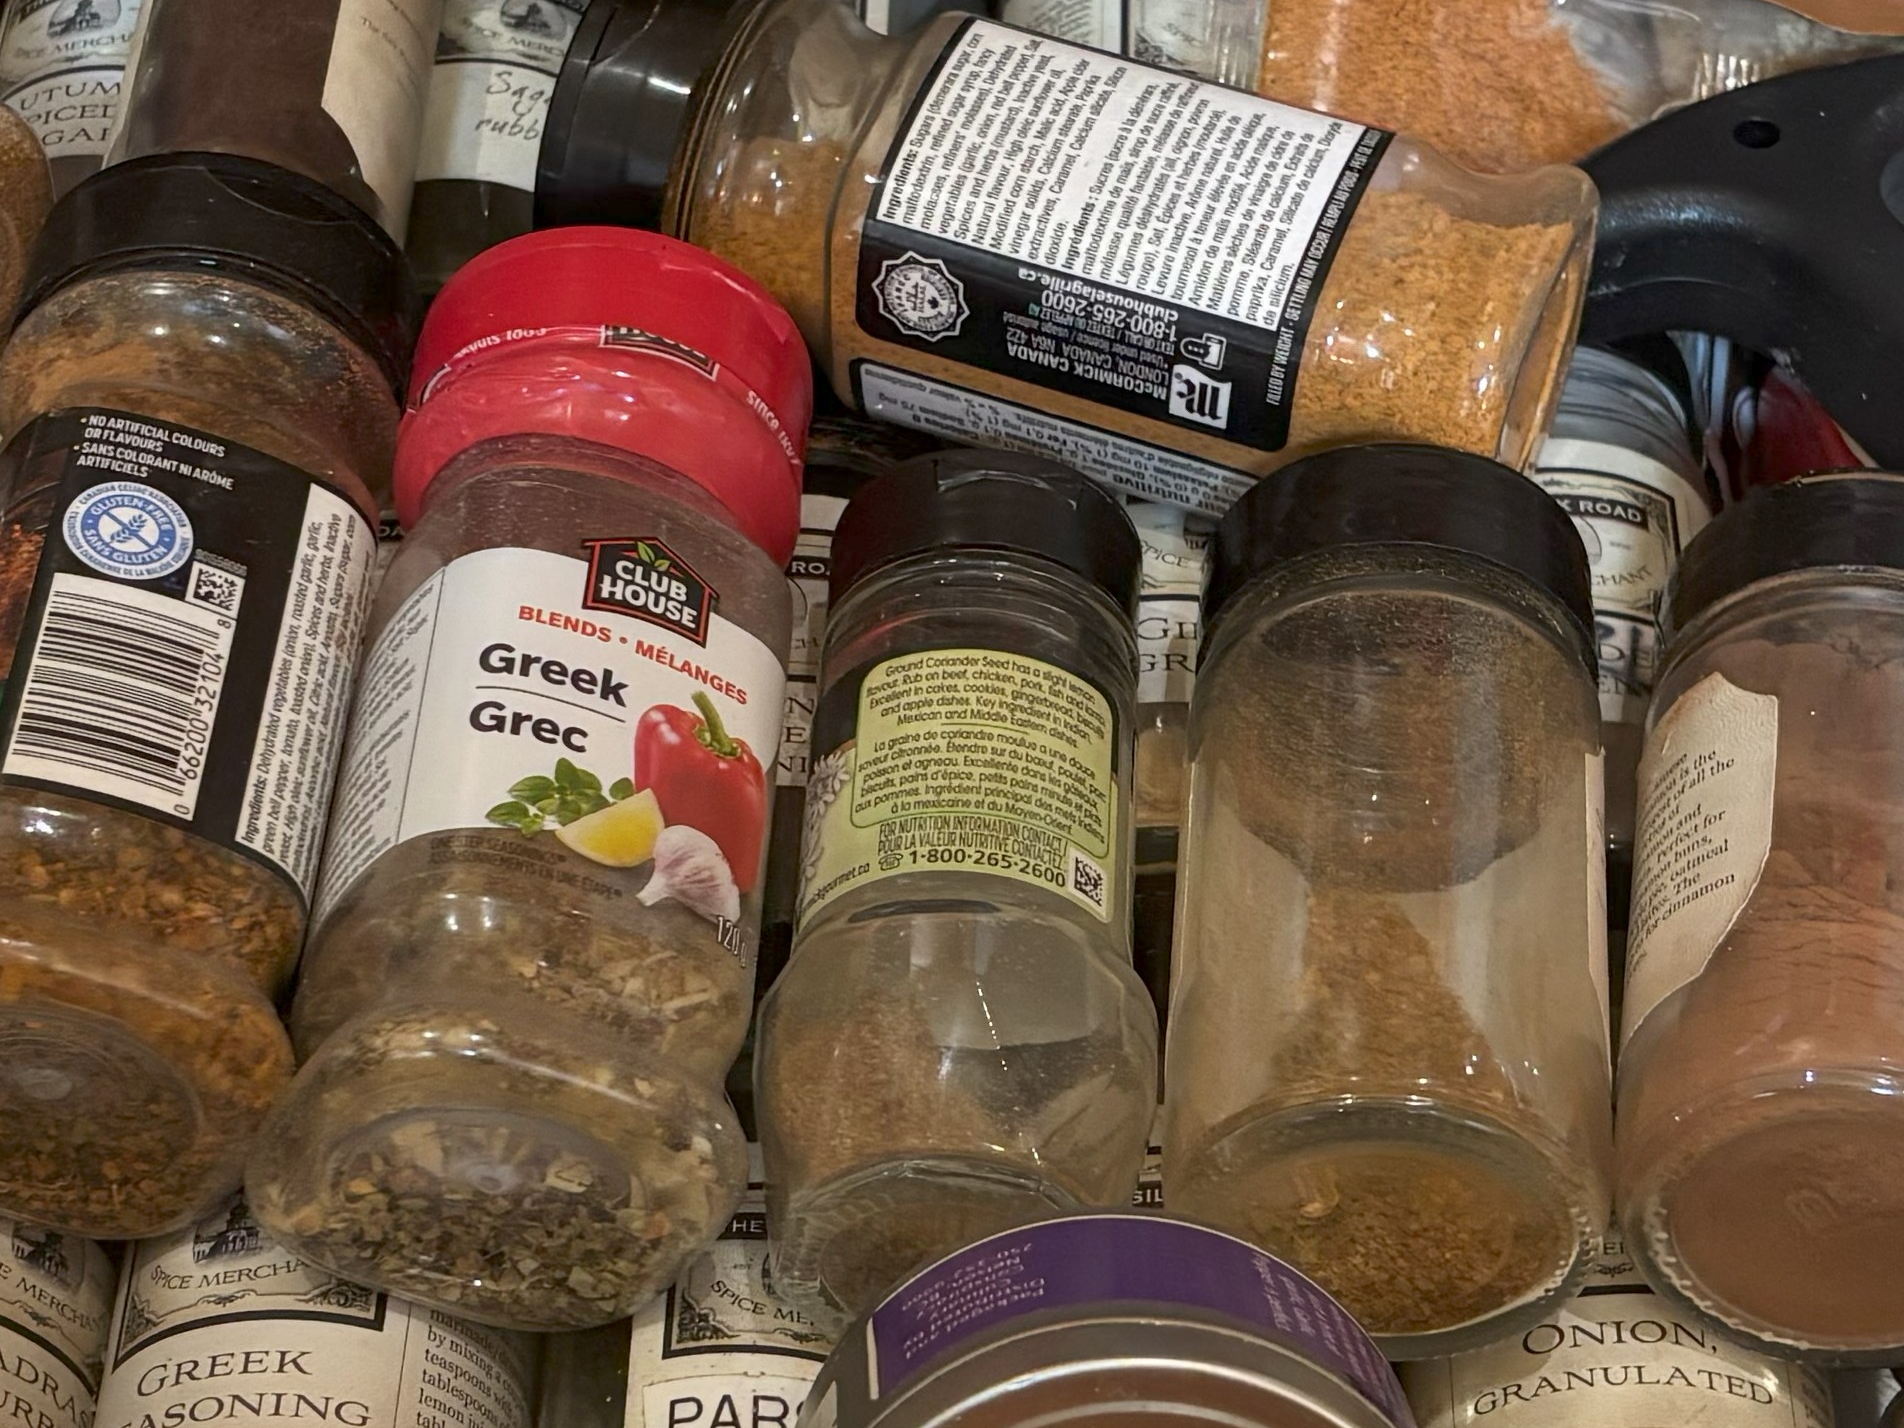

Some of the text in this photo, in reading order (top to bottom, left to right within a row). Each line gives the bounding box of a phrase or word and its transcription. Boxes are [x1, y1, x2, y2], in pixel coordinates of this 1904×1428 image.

[21, 81, 121, 111] UTUM
[486, 71, 552, 116] Sag
[475, 117, 540, 141] rubb
[883, 147, 920, 219] Ingredients:
[938, 172, 969, 234] vegetables
[972, 199, 996, 245] Natural
[1018, 267, 1178, 322] clubhouselagrille.ca
[1041, 289, 1177, 342] 1-800-265-2600
[1007, 342, 1070, 372] CANADA
[1266, 374, 1283, 406] FILLED
[1278, 326, 1295, 361] WEIGHT
[745, 389, 781, 431] since
[81, 442, 179, 471] SANS COLORANT
[102, 429, 164, 453] FLAVOURS
[107, 417, 226, 457] ARTIFICIAL COLOURS
[76, 455, 149, 478] ARTIFICIELS
[1579, 499, 1642, 523] ROAD
[599, 575, 698, 629] HOUSE
[614, 559, 689, 603] CLUB
[478, 642, 630, 708] Greek
[518, 605, 748, 705] BLENDS MÉLANGES
[885, 656, 980, 678] Ground Coriander
[195, 652, 225, 713] 32104
[178, 714, 211, 782] 66200
[469, 700, 589, 753] Grec
[1693, 749, 1717, 772] the
[242, 769, 268, 844] Ingredients:
[908, 848, 1067, 888] 1-800-265-2600
[1670, 839, 1730, 882] oatmeal
[1662, 873, 1736, 922] cinnamon
[731, 1219, 764, 1233] HE
[151, 1264, 194, 1290] SPICE
[710, 1279, 767, 1315] SPICE
[1522, 1320, 1718, 1355] ONION,
[137, 1350, 314, 1398] GREEK
[425, 1348, 492, 1397] teaspoons
[450, 1340, 495, 1380] mixing
[418, 1387, 465, 1424] lemon
[1473, 1365, 1775, 1416] GRANULATED
